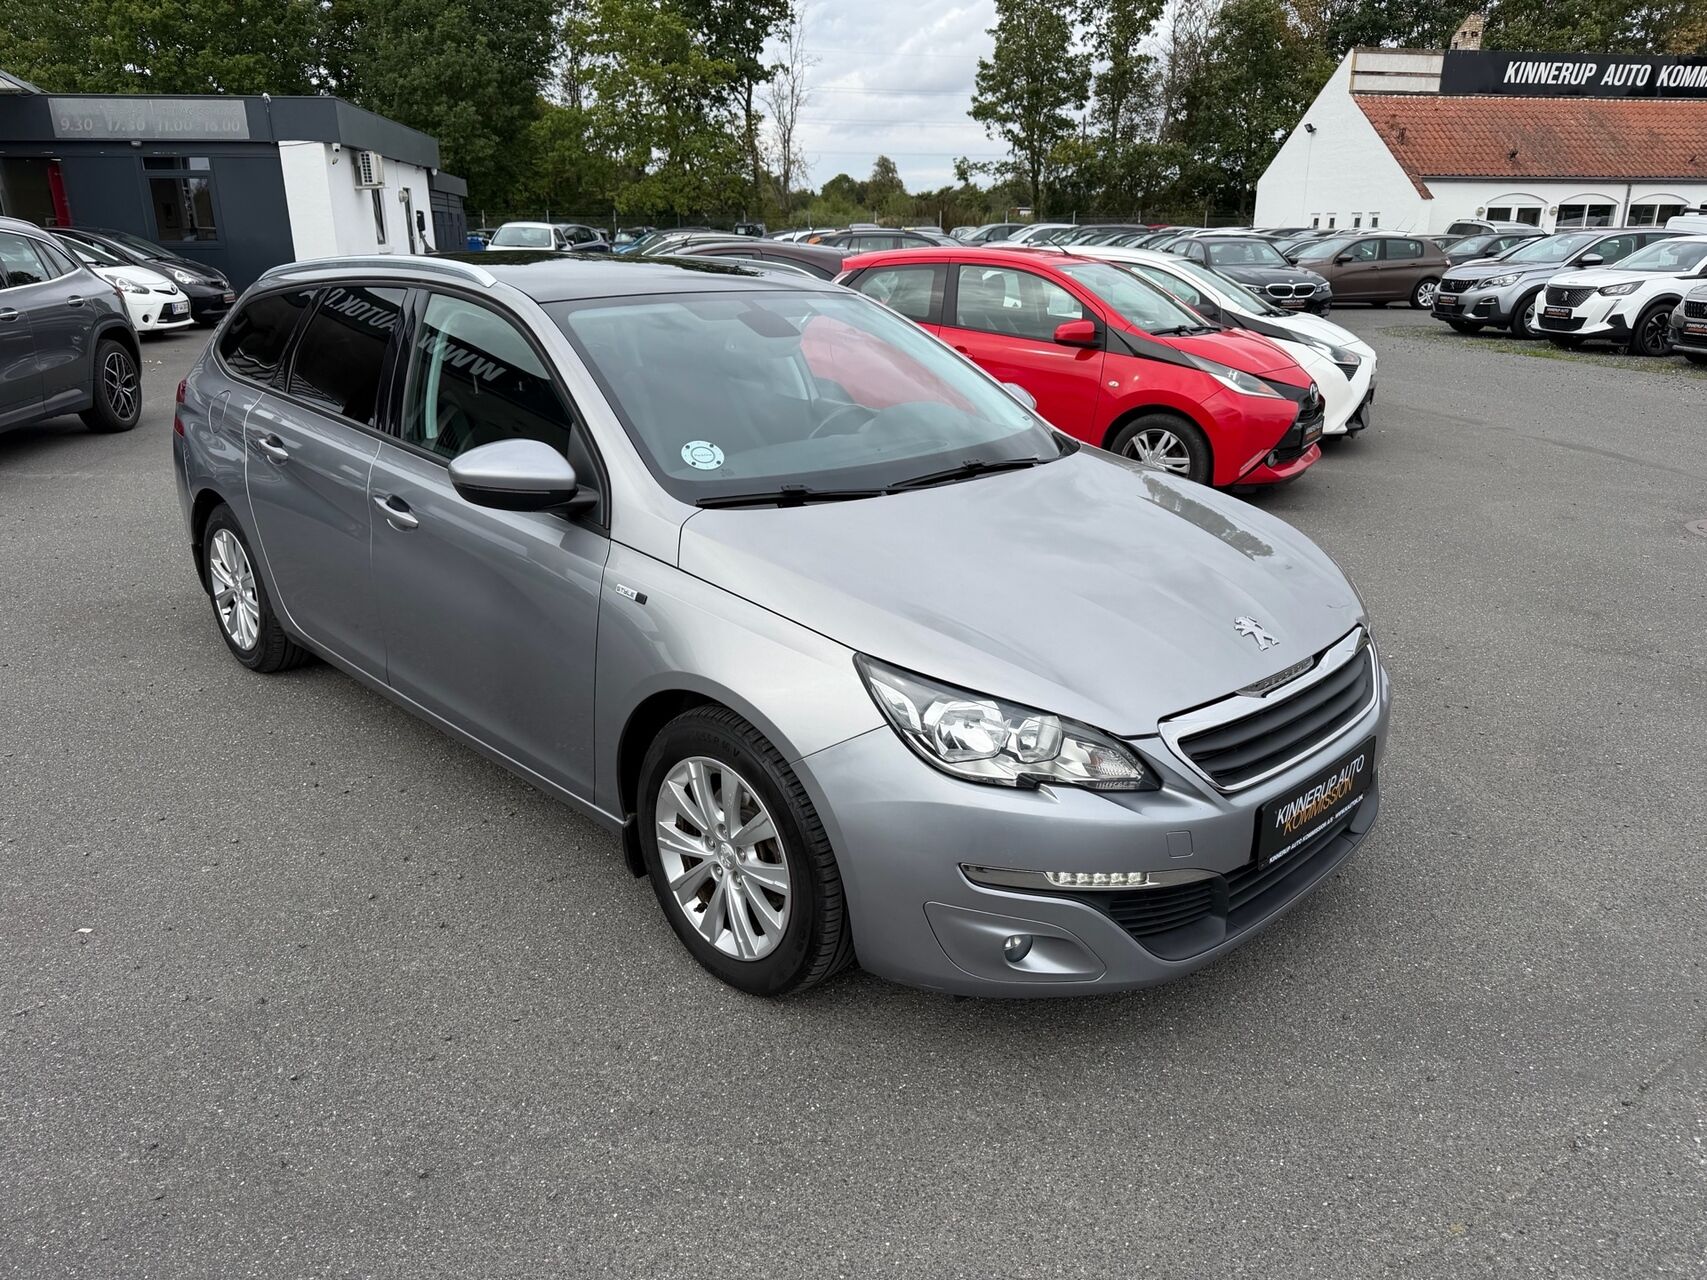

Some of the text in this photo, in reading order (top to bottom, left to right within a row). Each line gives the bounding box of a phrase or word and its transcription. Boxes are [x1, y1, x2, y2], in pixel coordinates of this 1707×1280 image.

[1503, 61, 1597, 86] KINNERUP
[1600, 64, 1651, 87] AUTO
[60, 117, 93, 131] 9.30
[1275, 754, 1365, 828] KINNERUP AUTO
[1283, 778, 1353, 836] KOMMISSION
